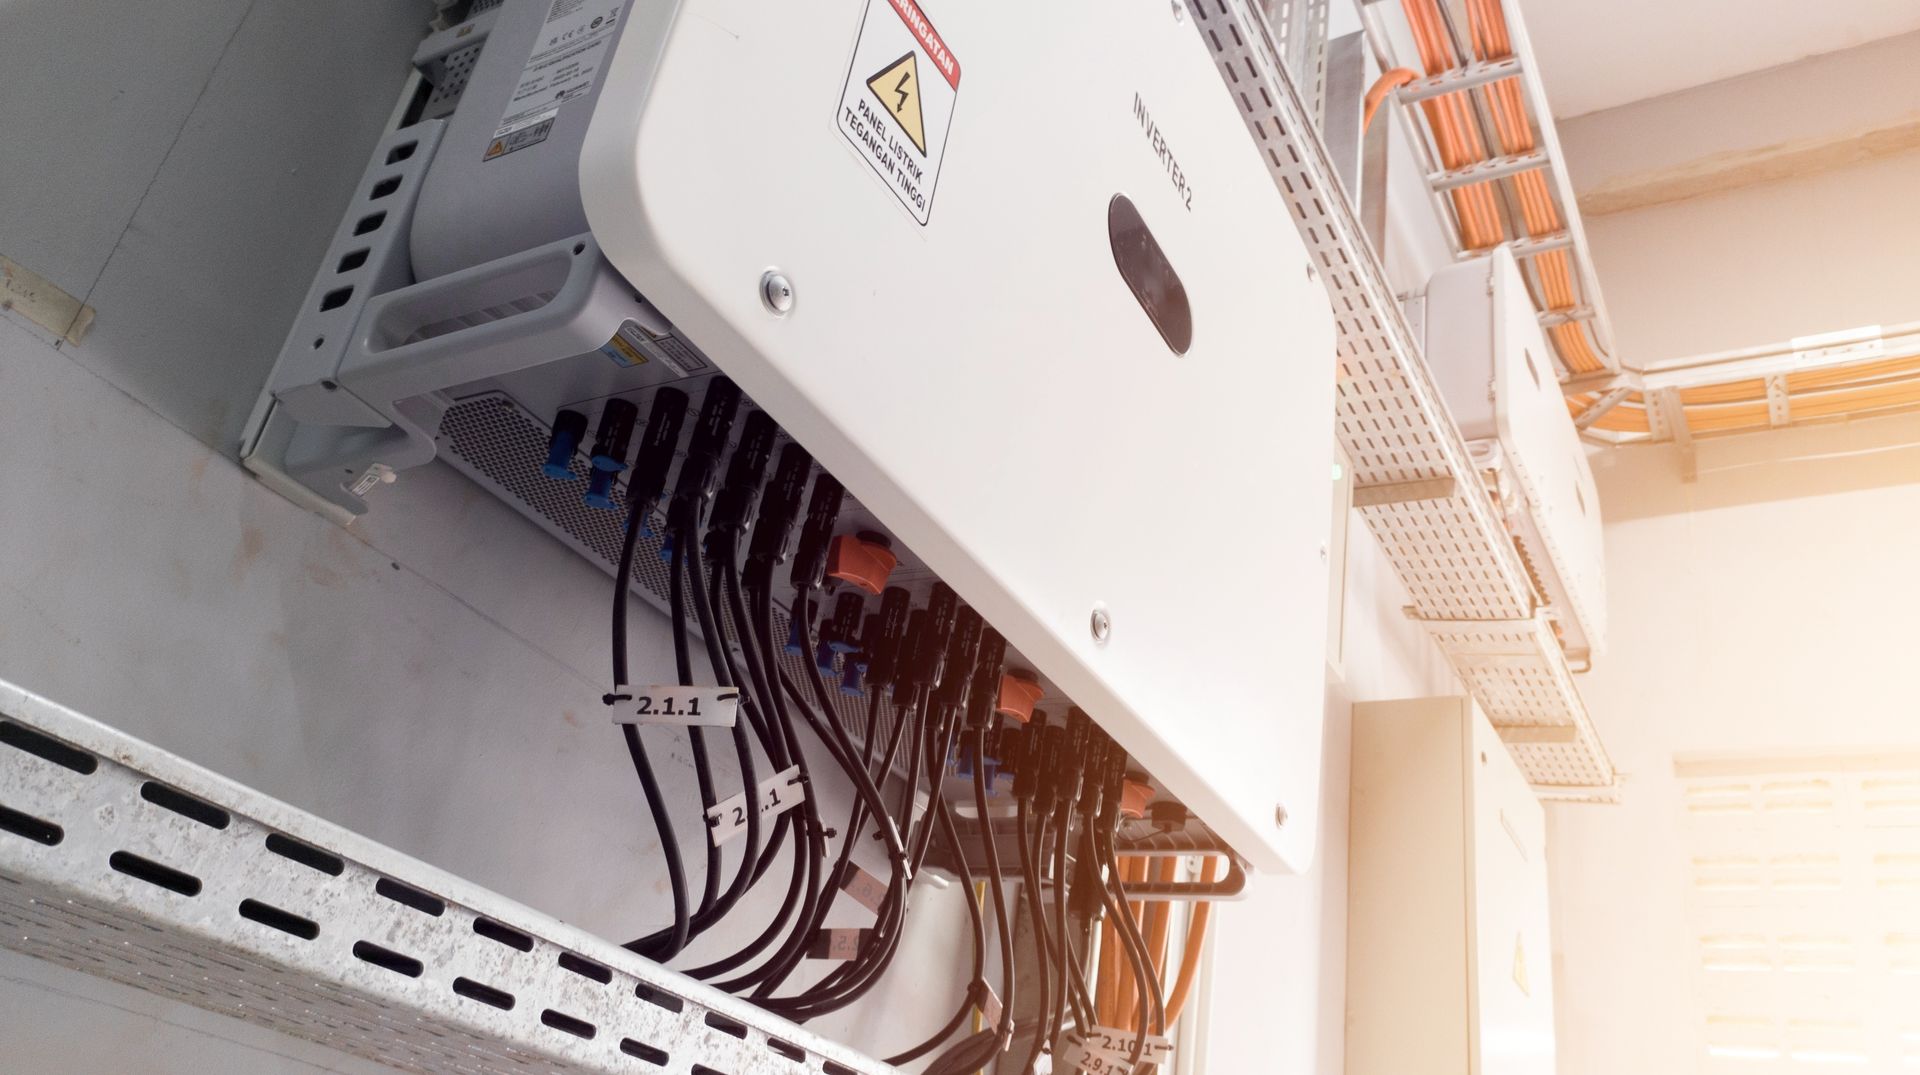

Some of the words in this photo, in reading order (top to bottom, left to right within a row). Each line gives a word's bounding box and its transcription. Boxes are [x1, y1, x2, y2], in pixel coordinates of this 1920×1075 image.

[895, 0, 953, 75] RINGATAN
[846, 107, 895, 175] TEGANGAN
[896, 168, 926, 212] TINGGI
[858, 99, 886, 142] PANEL
[888, 135, 923, 184] LISTRIK
[636, 696, 702, 716] 2.1.1
[1081, 1051, 1114, 1075] 2.9.1
[1102, 1035, 1153, 1056] 2.101
